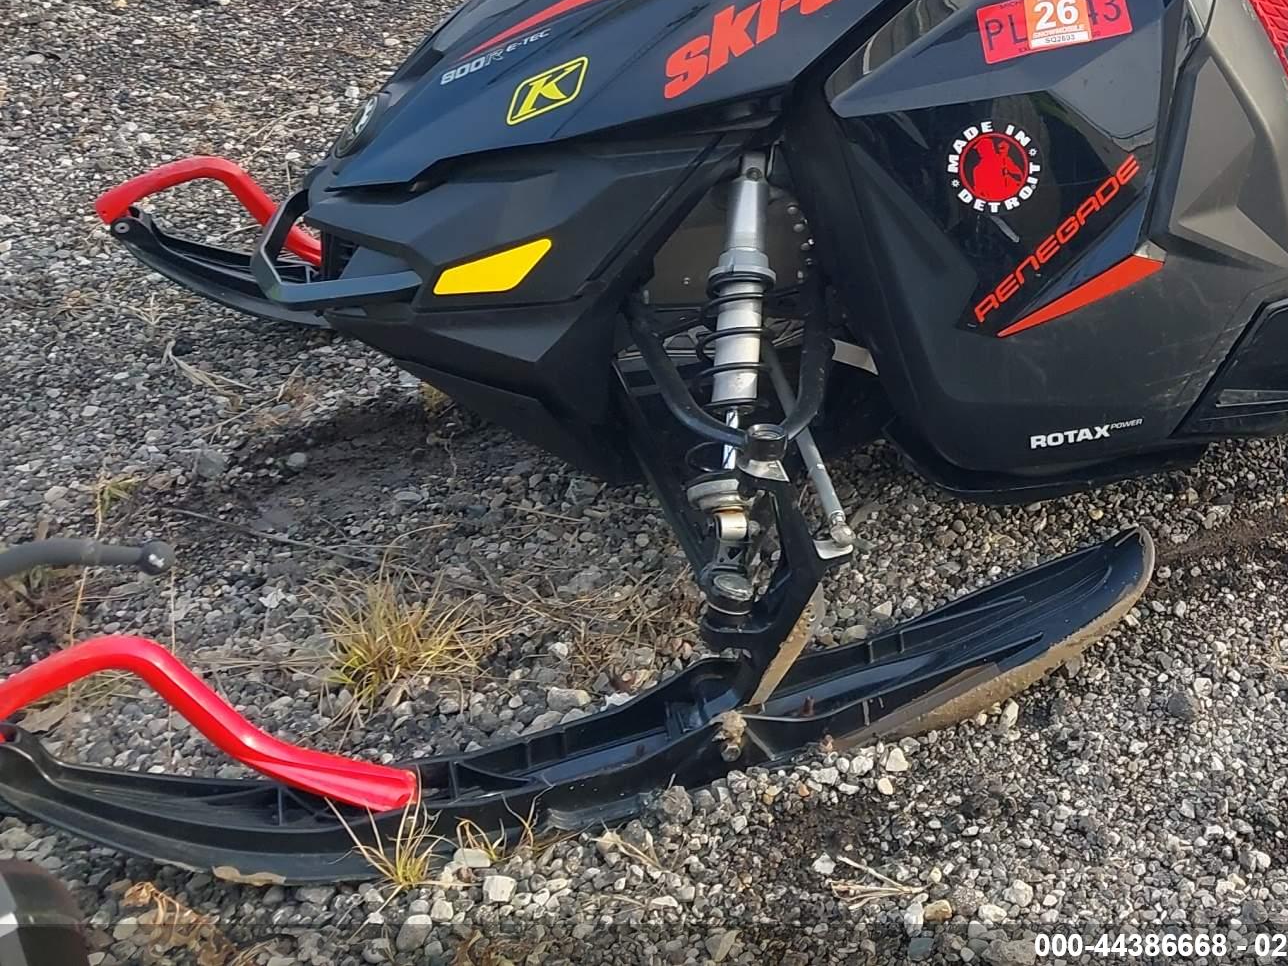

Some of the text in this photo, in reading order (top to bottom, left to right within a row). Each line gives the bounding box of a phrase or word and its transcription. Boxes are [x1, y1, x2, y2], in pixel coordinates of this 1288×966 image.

[947, 121, 1032, 173] MADE IN
[974, 154, 1140, 323] RENEGADE
[1030, 418, 1143, 449] ROTAX POWER
